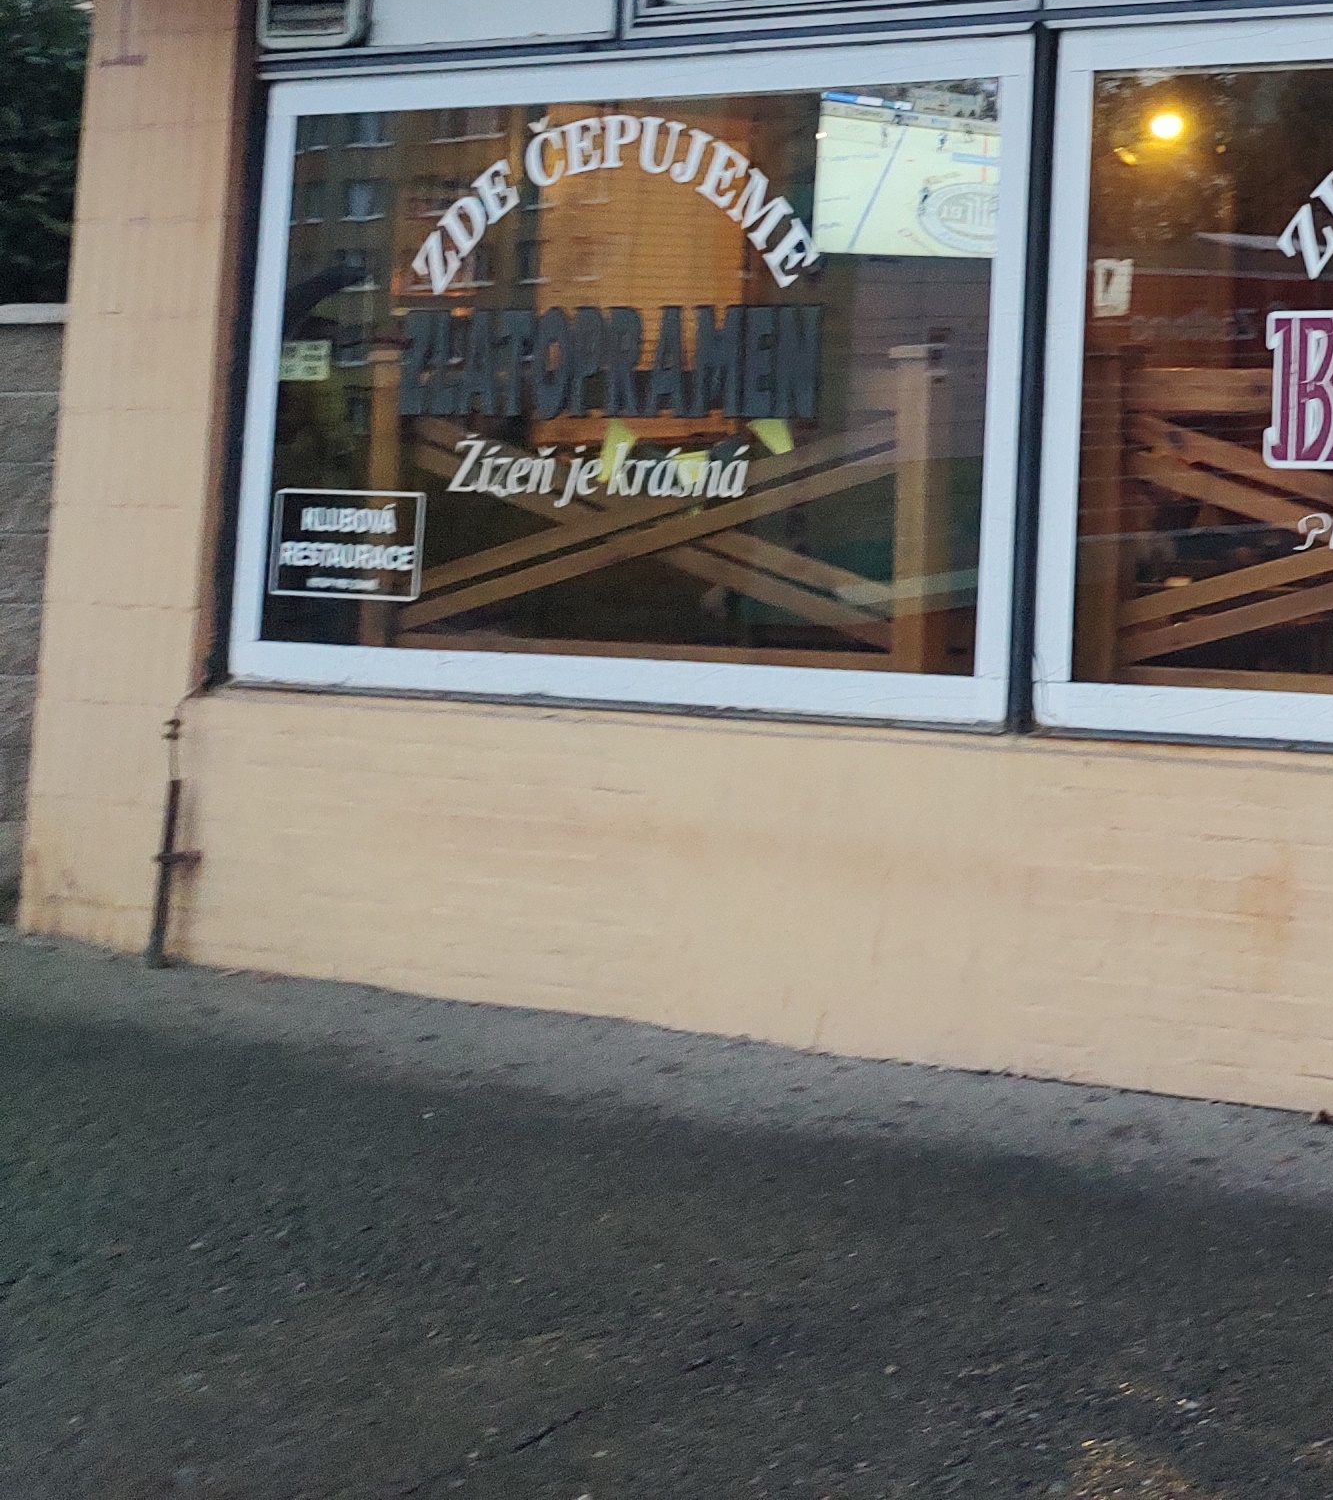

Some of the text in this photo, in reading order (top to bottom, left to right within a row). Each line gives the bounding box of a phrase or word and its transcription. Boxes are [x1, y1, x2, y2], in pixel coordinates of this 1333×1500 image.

[410, 113, 821, 296] ZDE ČEPUJEME
[400, 303, 823, 419] ZLATOPRAMEN
[446, 433, 751, 509] Žízeň je krásná
